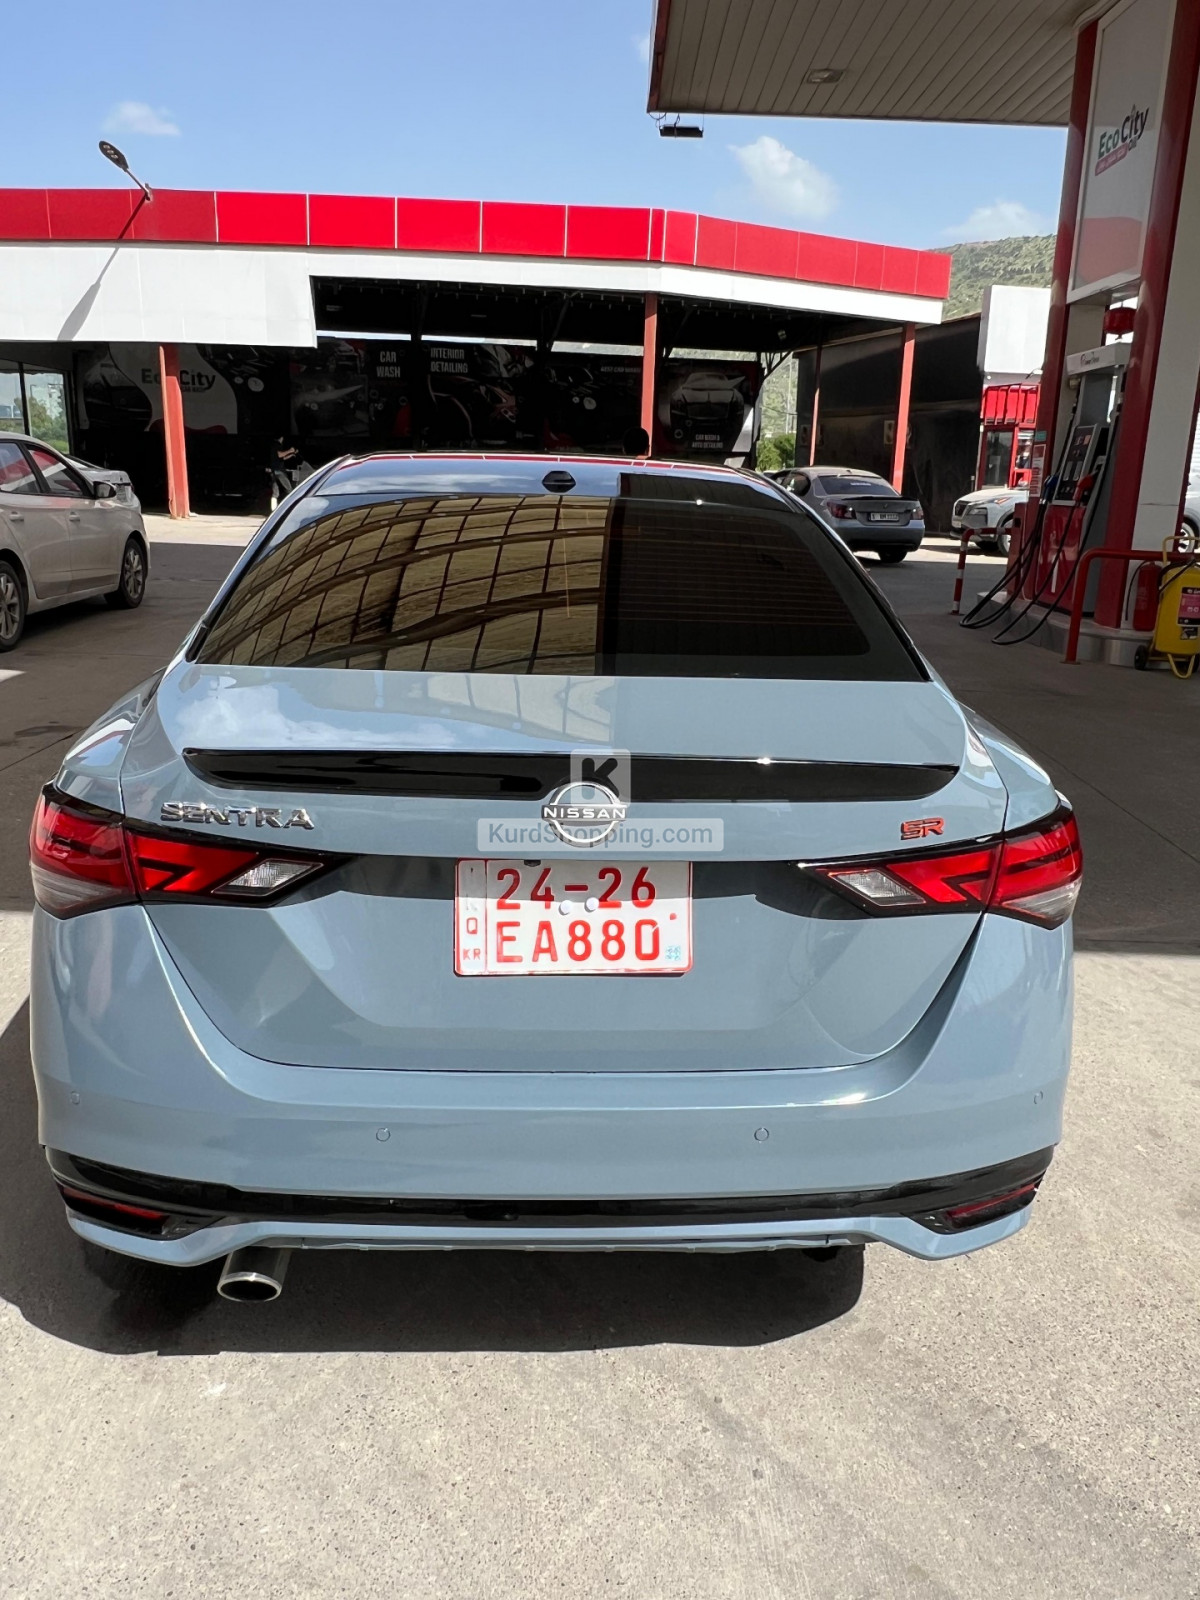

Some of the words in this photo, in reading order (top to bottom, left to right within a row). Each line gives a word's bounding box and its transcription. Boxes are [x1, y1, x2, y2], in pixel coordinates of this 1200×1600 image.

[1098, 106, 1149, 159] EcoCity
[380, 351, 397, 363] CAR
[430, 348, 465, 360] INTERIOR
[376, 366, 401, 378] WASH
[430, 361, 468, 374] DETAILING
[161, 802, 314, 829] SENTRA
[543, 806, 626, 819] NISSAN
[901, 817, 944, 840] SR
[496, 919, 660, 963] EA880
[462, 948, 481, 960] KR
